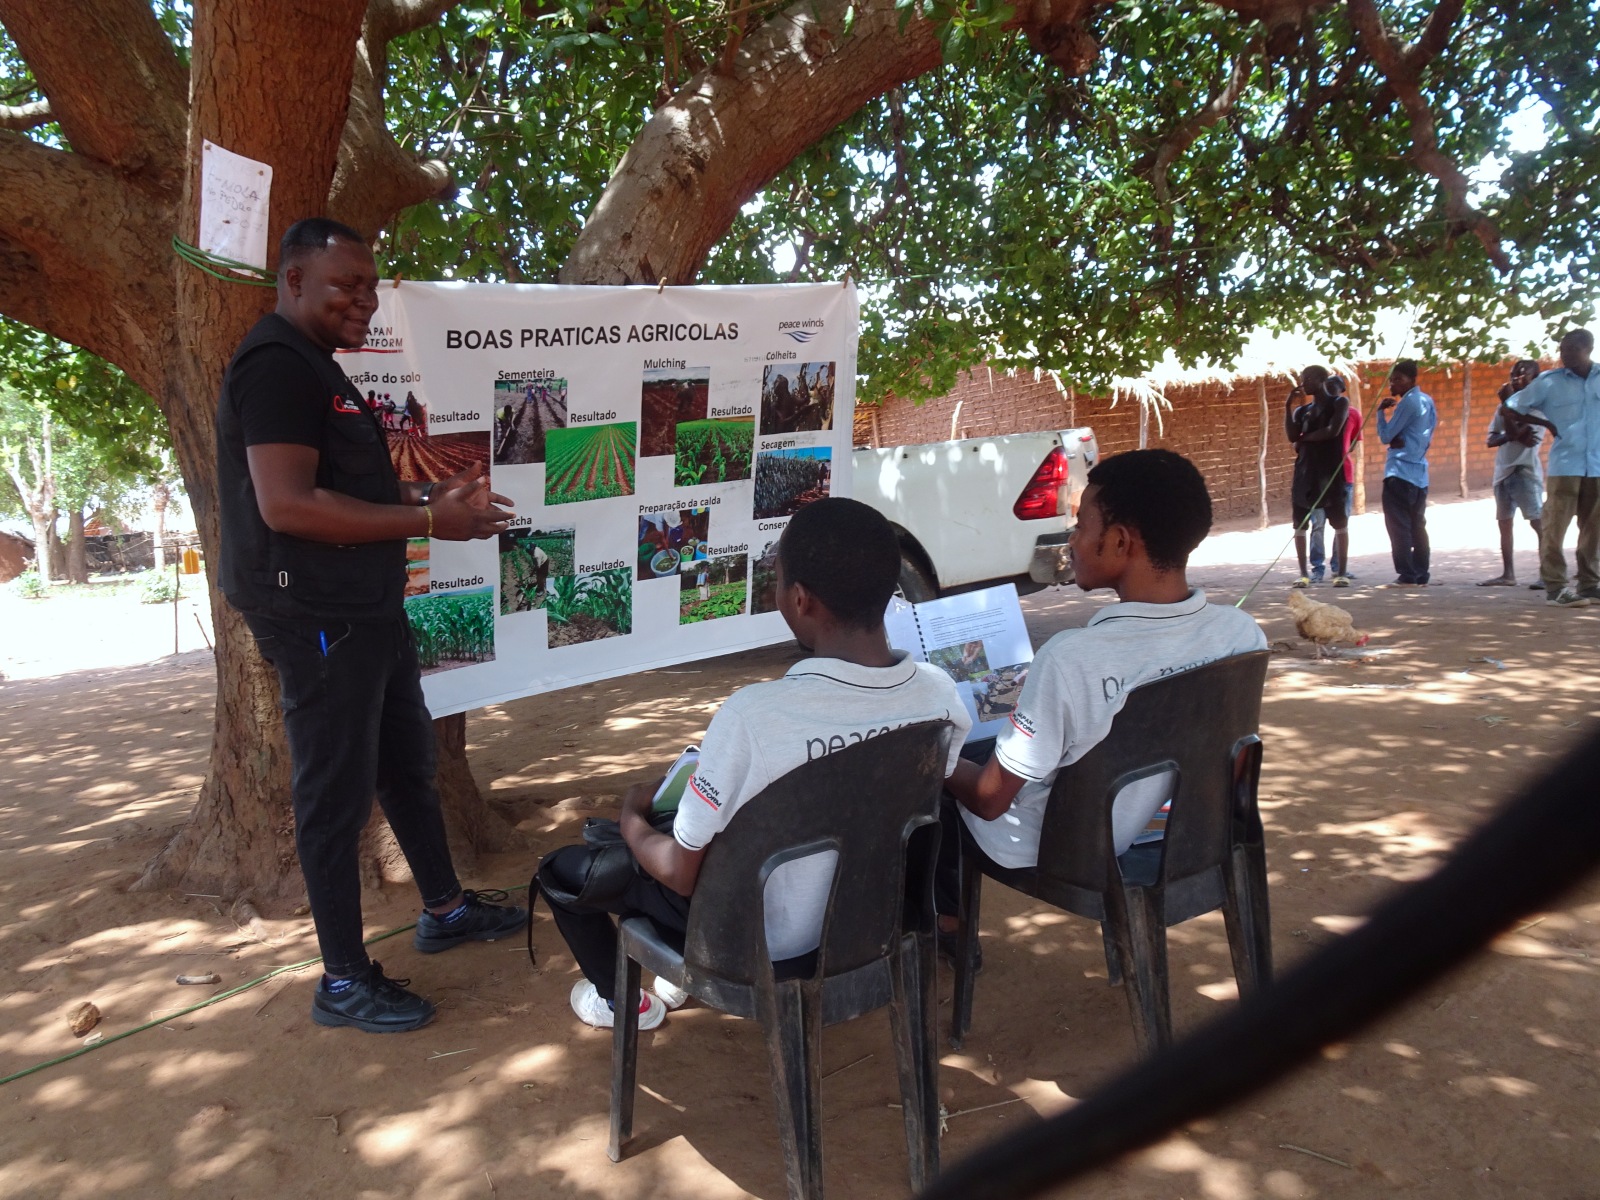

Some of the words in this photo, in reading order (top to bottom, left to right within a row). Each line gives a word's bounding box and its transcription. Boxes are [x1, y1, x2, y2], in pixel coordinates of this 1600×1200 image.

[366, 326, 393, 336] APAN
[778, 320, 801, 331] peace
[801, 318, 824, 328] winds
[364, 337, 403, 347] ATFORM
[446, 329, 513, 350] BOAS
[520, 325, 621, 348] PRATICAS
[626, 322, 739, 343] AGRICOLAS
[766, 350, 797, 361] Colheita
[643, 358, 686, 369] Mulching
[381, 372, 398, 384] do
[400, 371, 421, 383] solo
[498, 368, 555, 380] Sementeira
[429, 410, 480, 424] Resultado
[570, 410, 617, 423] Resultado
[711, 405, 753, 417] Resultado
[761, 438, 796, 450] Secagem
[639, 500, 687, 513] Preparação
[687, 498, 698, 508] da
[700, 496, 721, 506] calda
[505, 516, 532, 526] acha
[758, 521, 788, 531] Conser
[708, 543, 749, 556] Resultado
[579, 559, 625, 574] Resultado
[430, 575, 485, 590] Resultado
[692, 777, 723, 808] PLATFORM
[698, 776, 720, 797] JAPAN
